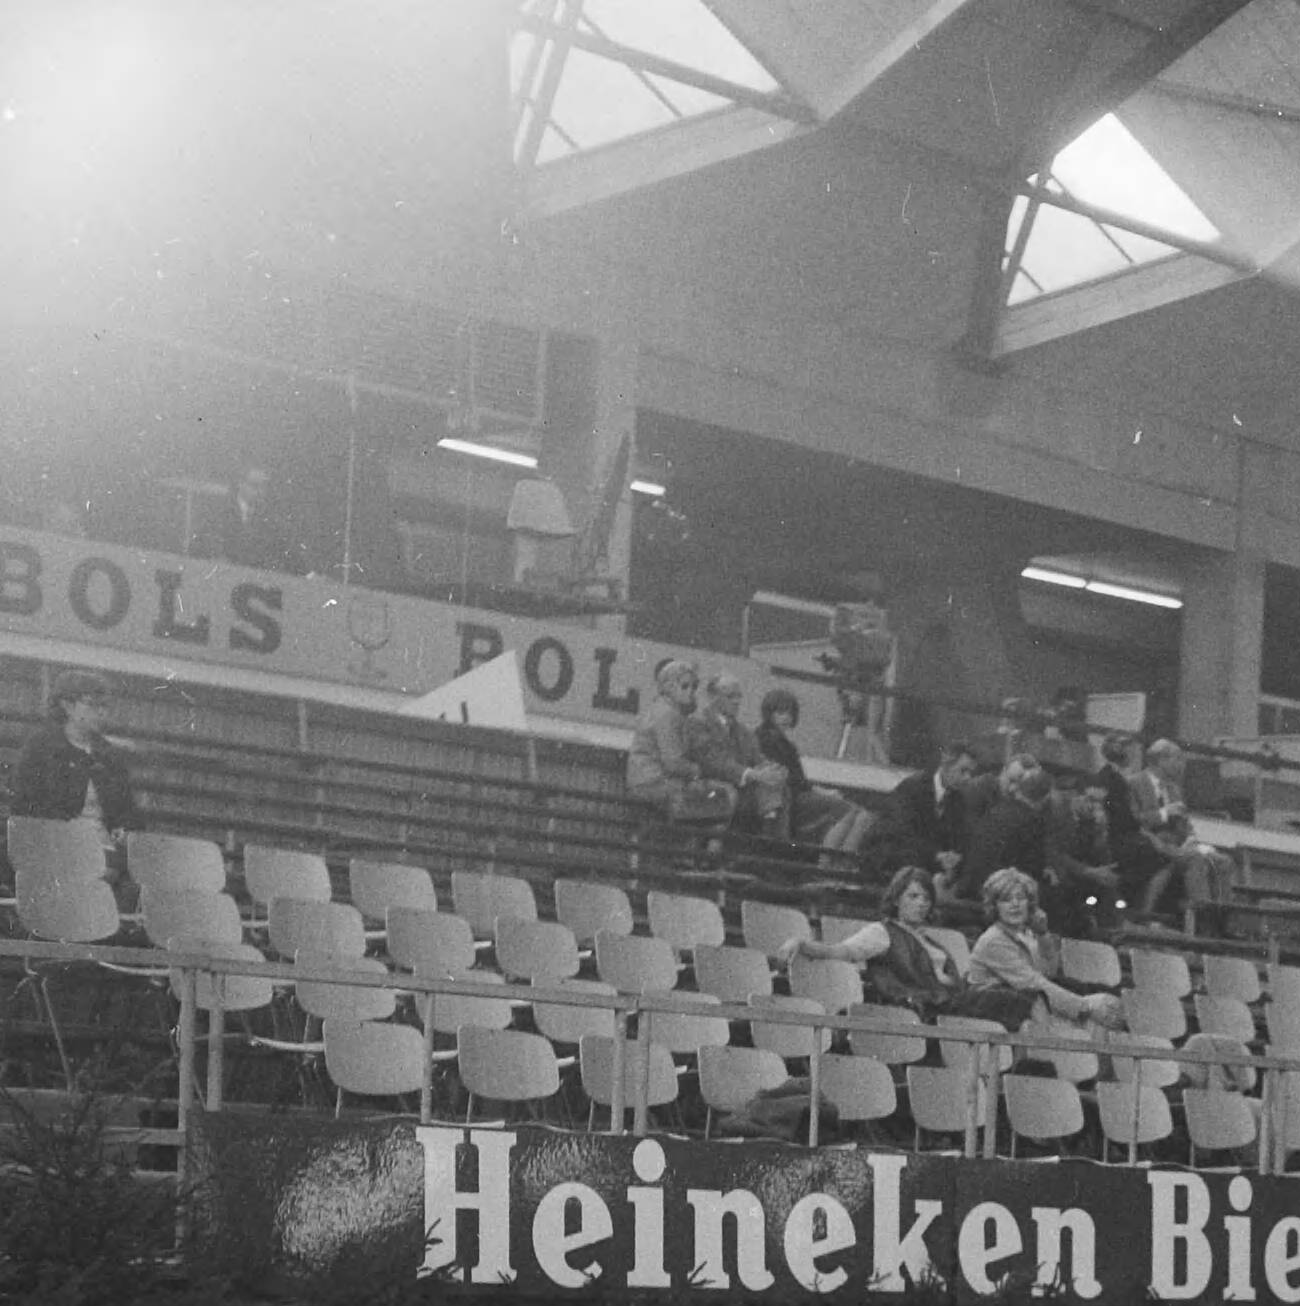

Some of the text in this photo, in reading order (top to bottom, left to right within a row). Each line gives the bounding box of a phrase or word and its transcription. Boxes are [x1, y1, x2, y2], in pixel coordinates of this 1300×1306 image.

[0, 540, 675, 715] BOLS BOL
[416, 1126, 1101, 1299] Heineken
